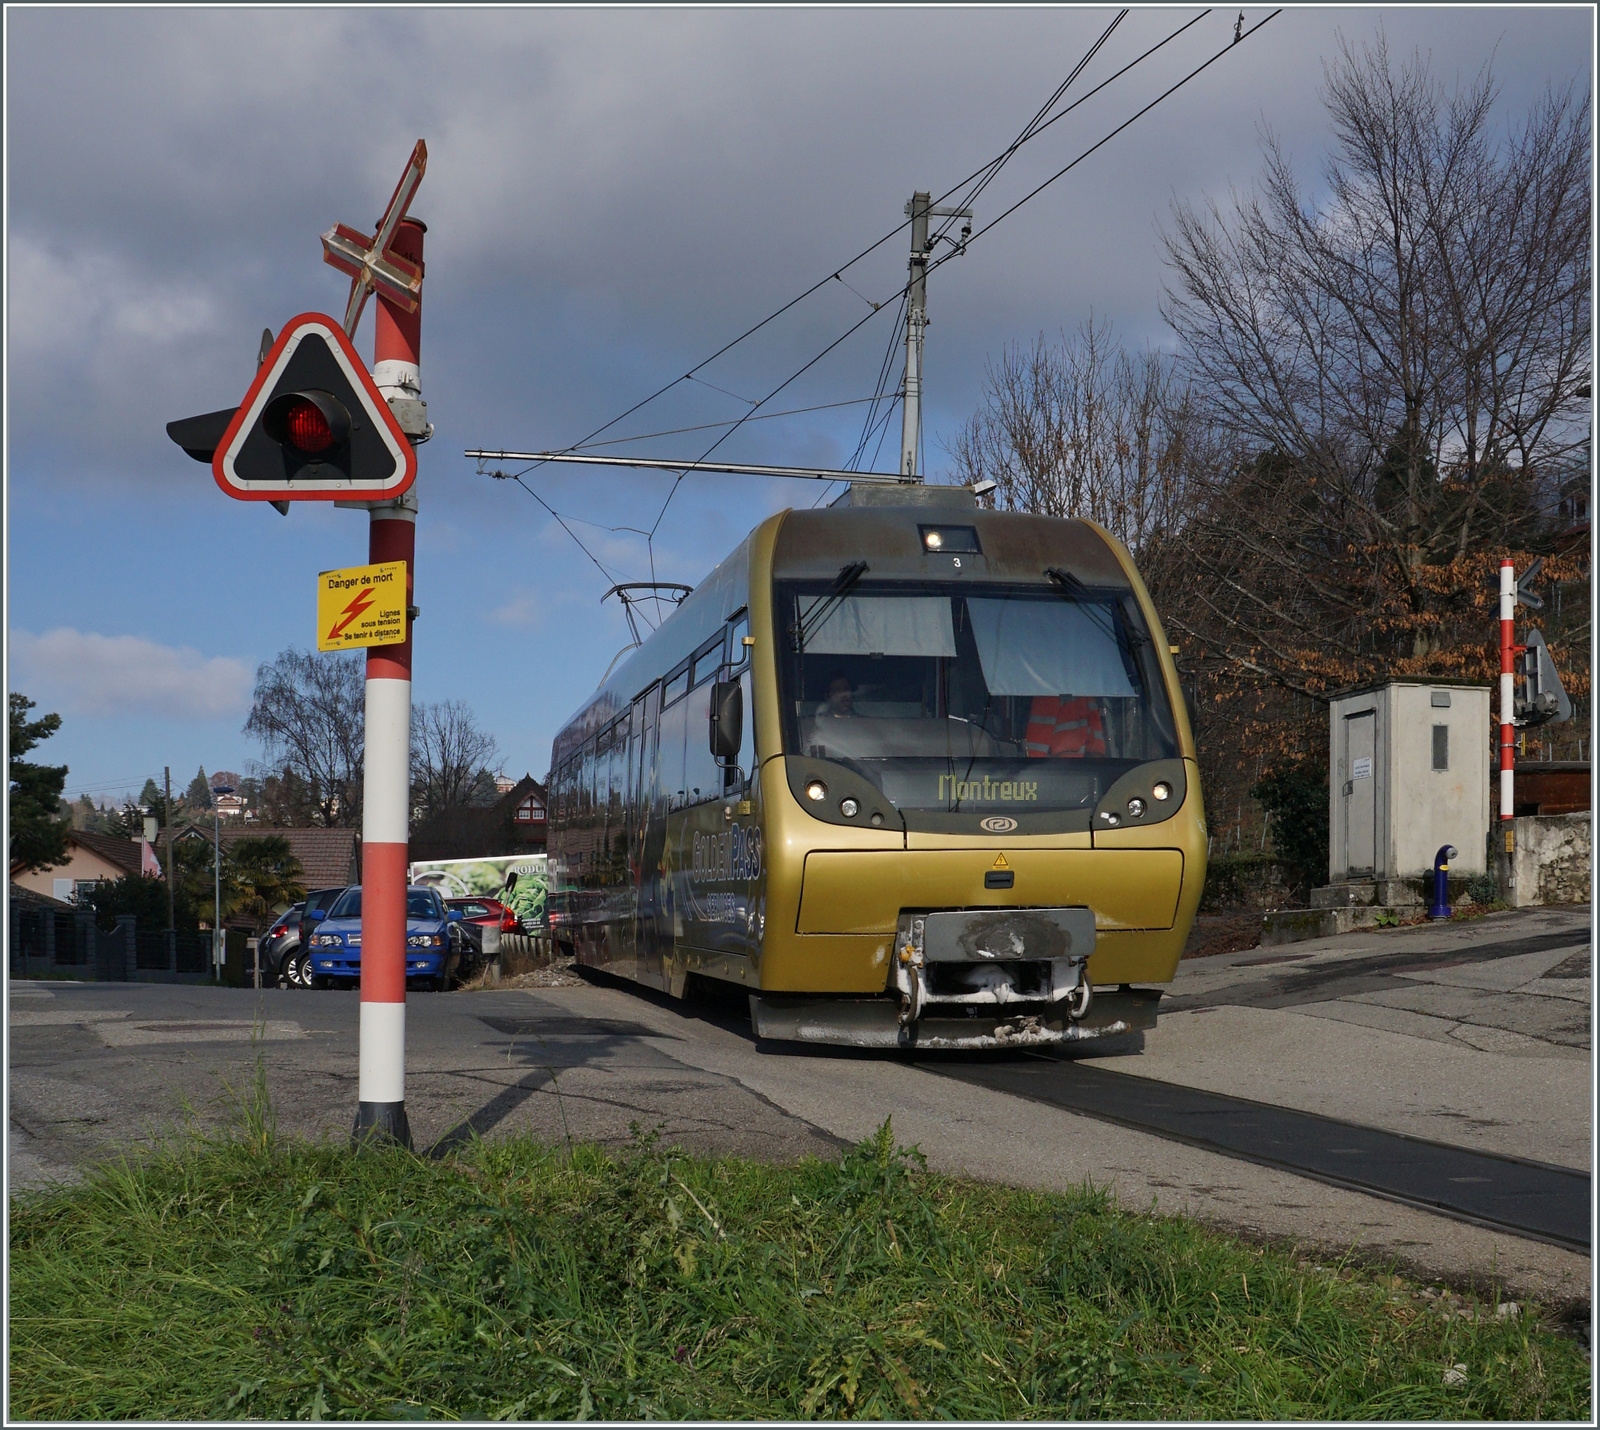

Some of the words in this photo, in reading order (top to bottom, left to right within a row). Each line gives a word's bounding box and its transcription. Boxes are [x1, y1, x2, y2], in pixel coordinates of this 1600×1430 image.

[953, 557, 962, 568] 3
[328, 577, 359, 589] Danger
[360, 575, 371, 585] de
[373, 572, 393, 582] mort
[379, 610, 401, 619] Lignes
[377, 618, 401, 626] tension
[344, 632, 353, 640] Se
[353, 631, 368, 639] tenir
[374, 629, 401, 637] distance
[938, 775, 1038, 800] Montreux
